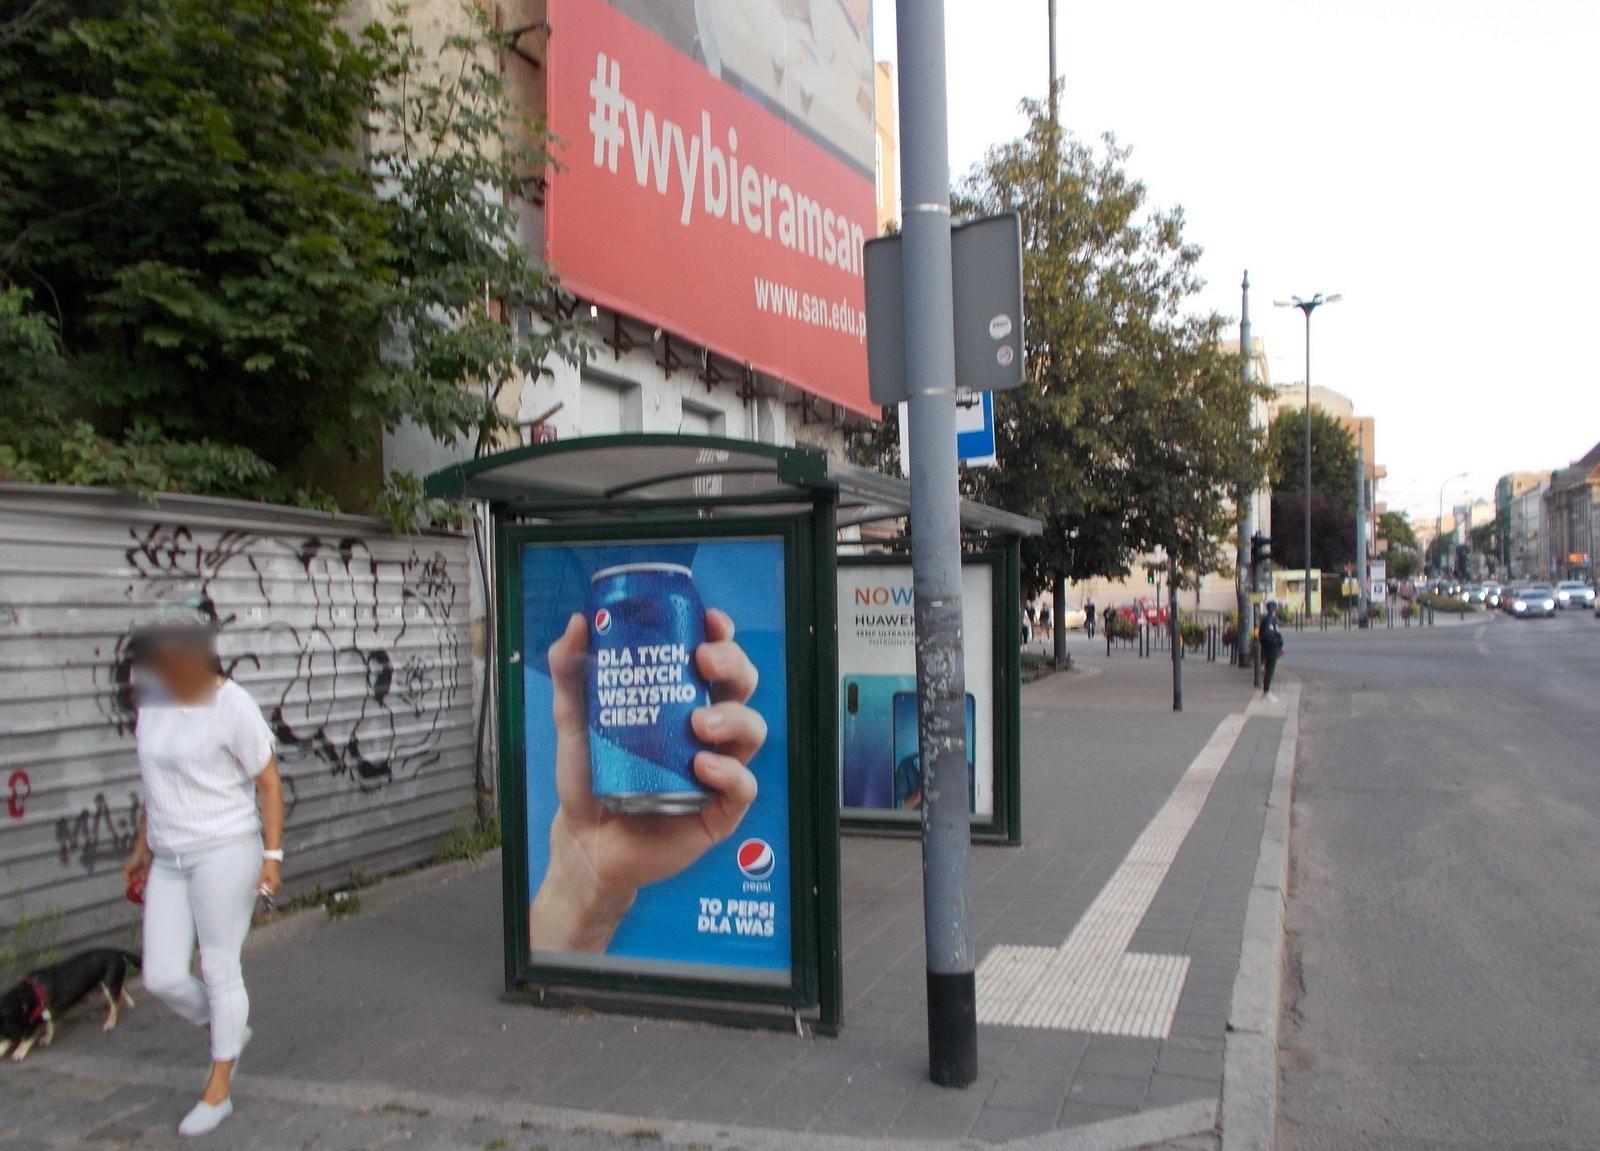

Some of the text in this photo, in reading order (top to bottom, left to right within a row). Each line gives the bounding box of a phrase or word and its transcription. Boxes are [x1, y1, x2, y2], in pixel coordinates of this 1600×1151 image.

[598, 648, 633, 667] DLA
[598, 683, 697, 707] WSZYSTKO
[600, 705, 661, 727] CIESZY
[699, 897, 775, 919] TO PEPSI
[698, 914, 775, 937] DLA WAS
